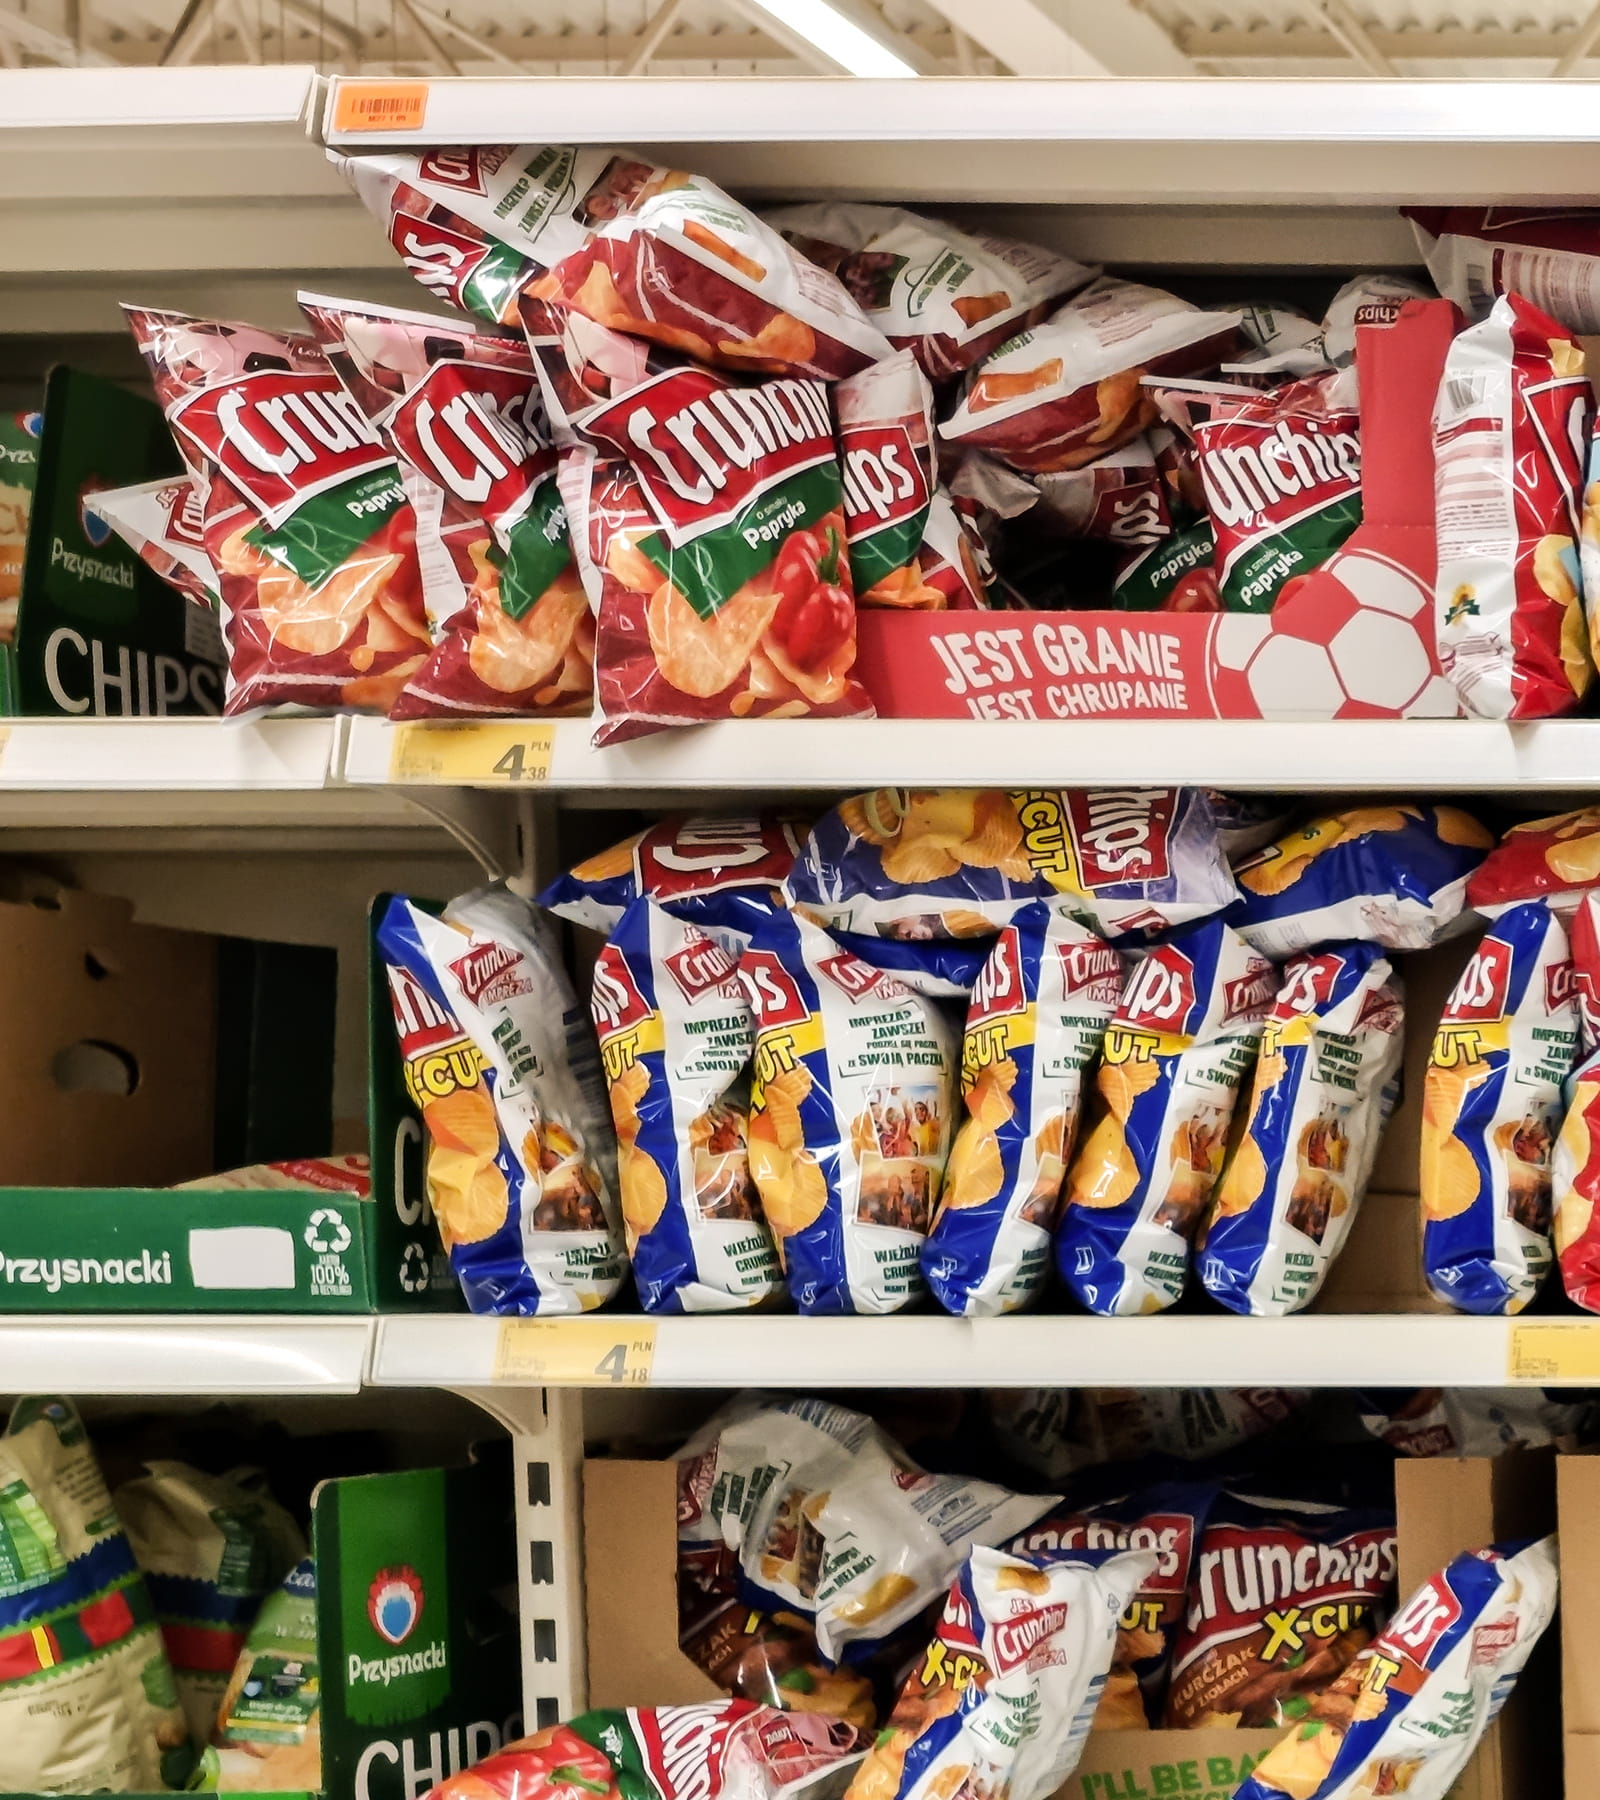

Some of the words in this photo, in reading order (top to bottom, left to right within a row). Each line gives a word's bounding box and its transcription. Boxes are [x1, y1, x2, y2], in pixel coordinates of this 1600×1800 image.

[742, 498, 805, 550] Papryka
[51, 544, 135, 590] Przysnacki
[1151, 537, 1213, 588] Papryka
[1241, 550, 1304, 605] Papryka
[929, 627, 1027, 695] JEST
[1033, 622, 1185, 678] GRANIE
[1046, 679, 1188, 717] CHRUPANIE
[493, 745, 526, 780] 4
[848, 1010, 911, 1028] IMPREZA?
[859, 1052, 904, 1067] SWOJĄ
[311, 1263, 350, 1285] 100%
[594, 1344, 628, 1382] 4
[632, 1340, 652, 1352] PLN
[631, 1366, 649, 1382] 18
[348, 1641, 446, 1690] Przysnacki
[1151, 1759, 1198, 1792] BE
